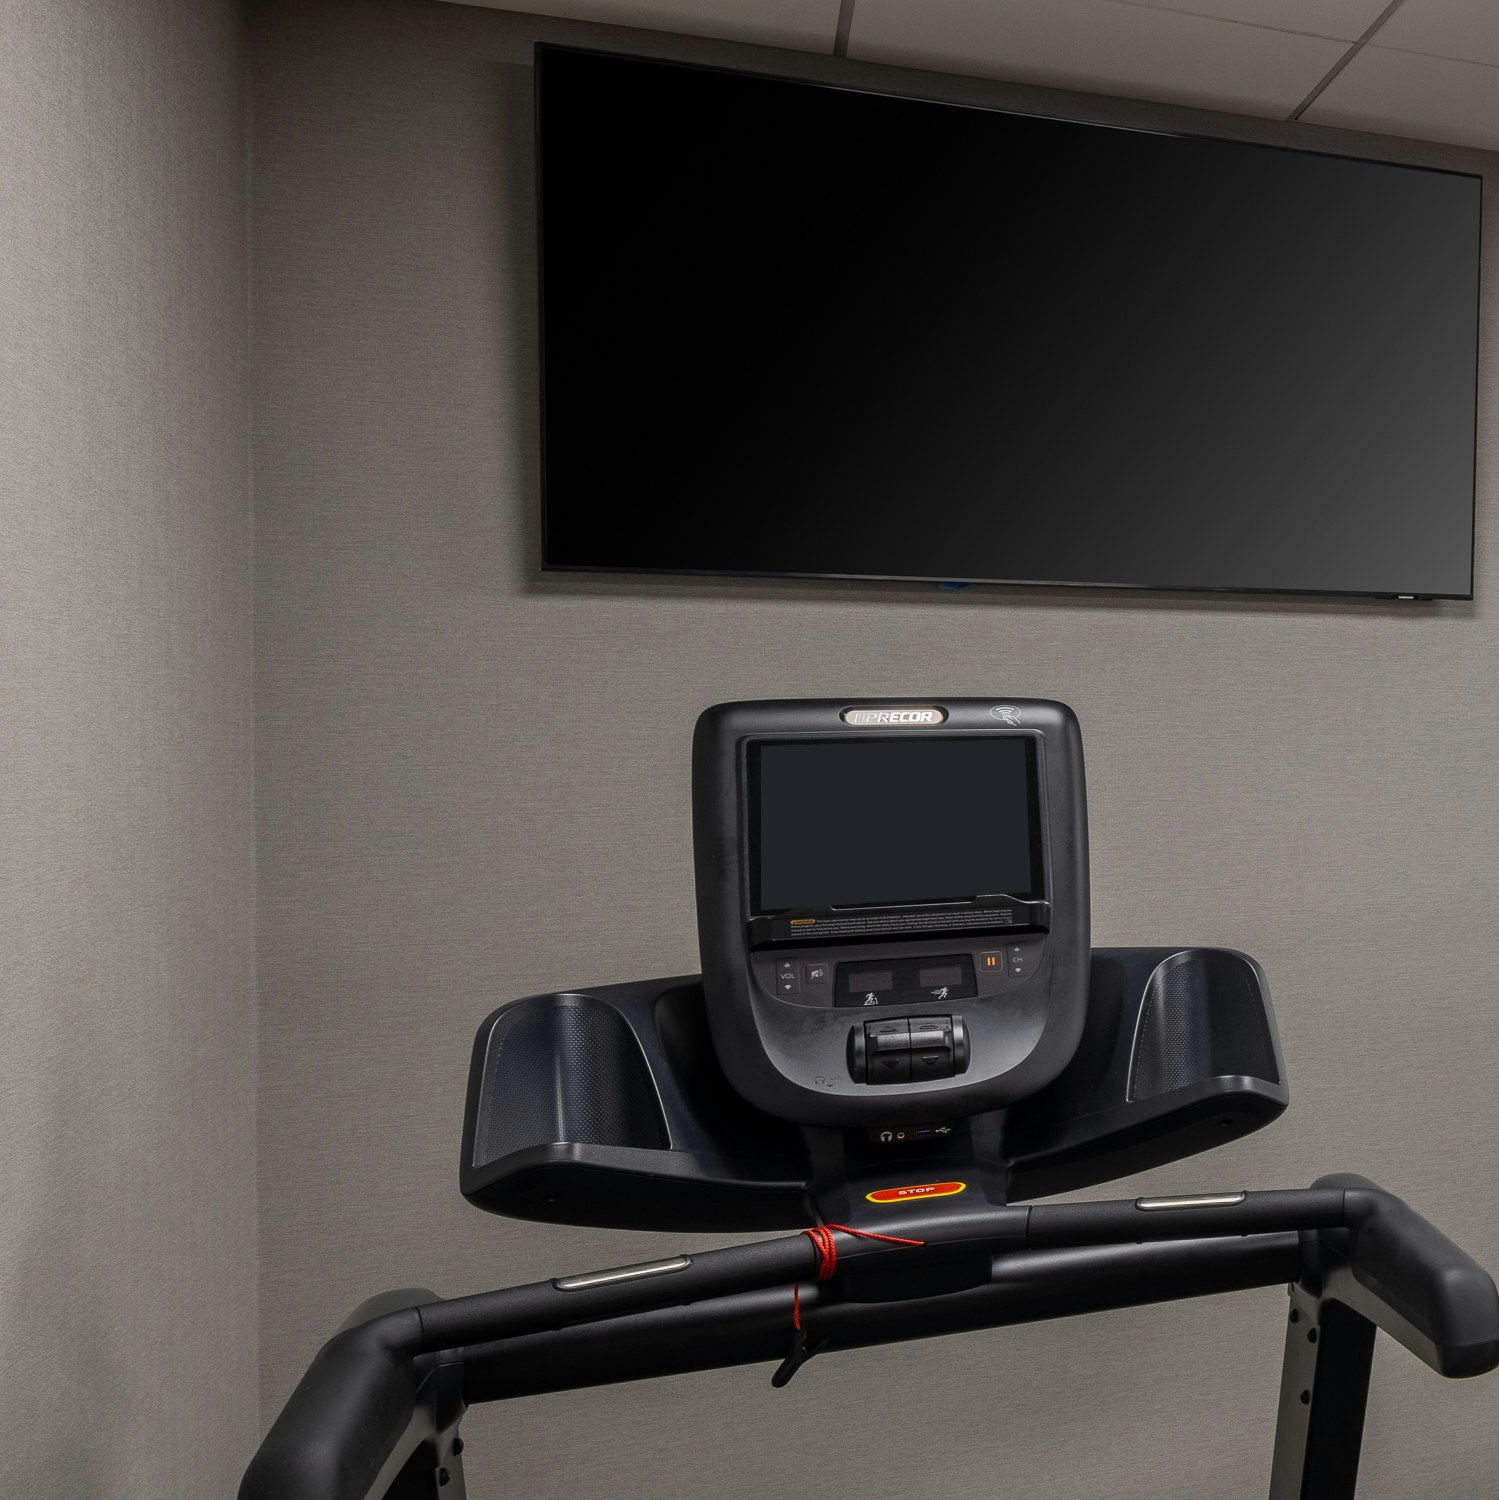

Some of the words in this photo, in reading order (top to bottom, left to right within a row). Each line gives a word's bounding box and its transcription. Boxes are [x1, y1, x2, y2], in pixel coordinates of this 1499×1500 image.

[866, 712, 932, 723] PRECOR
[780, 972, 795, 980] VOL
[898, 1186, 936, 1196] STOP
